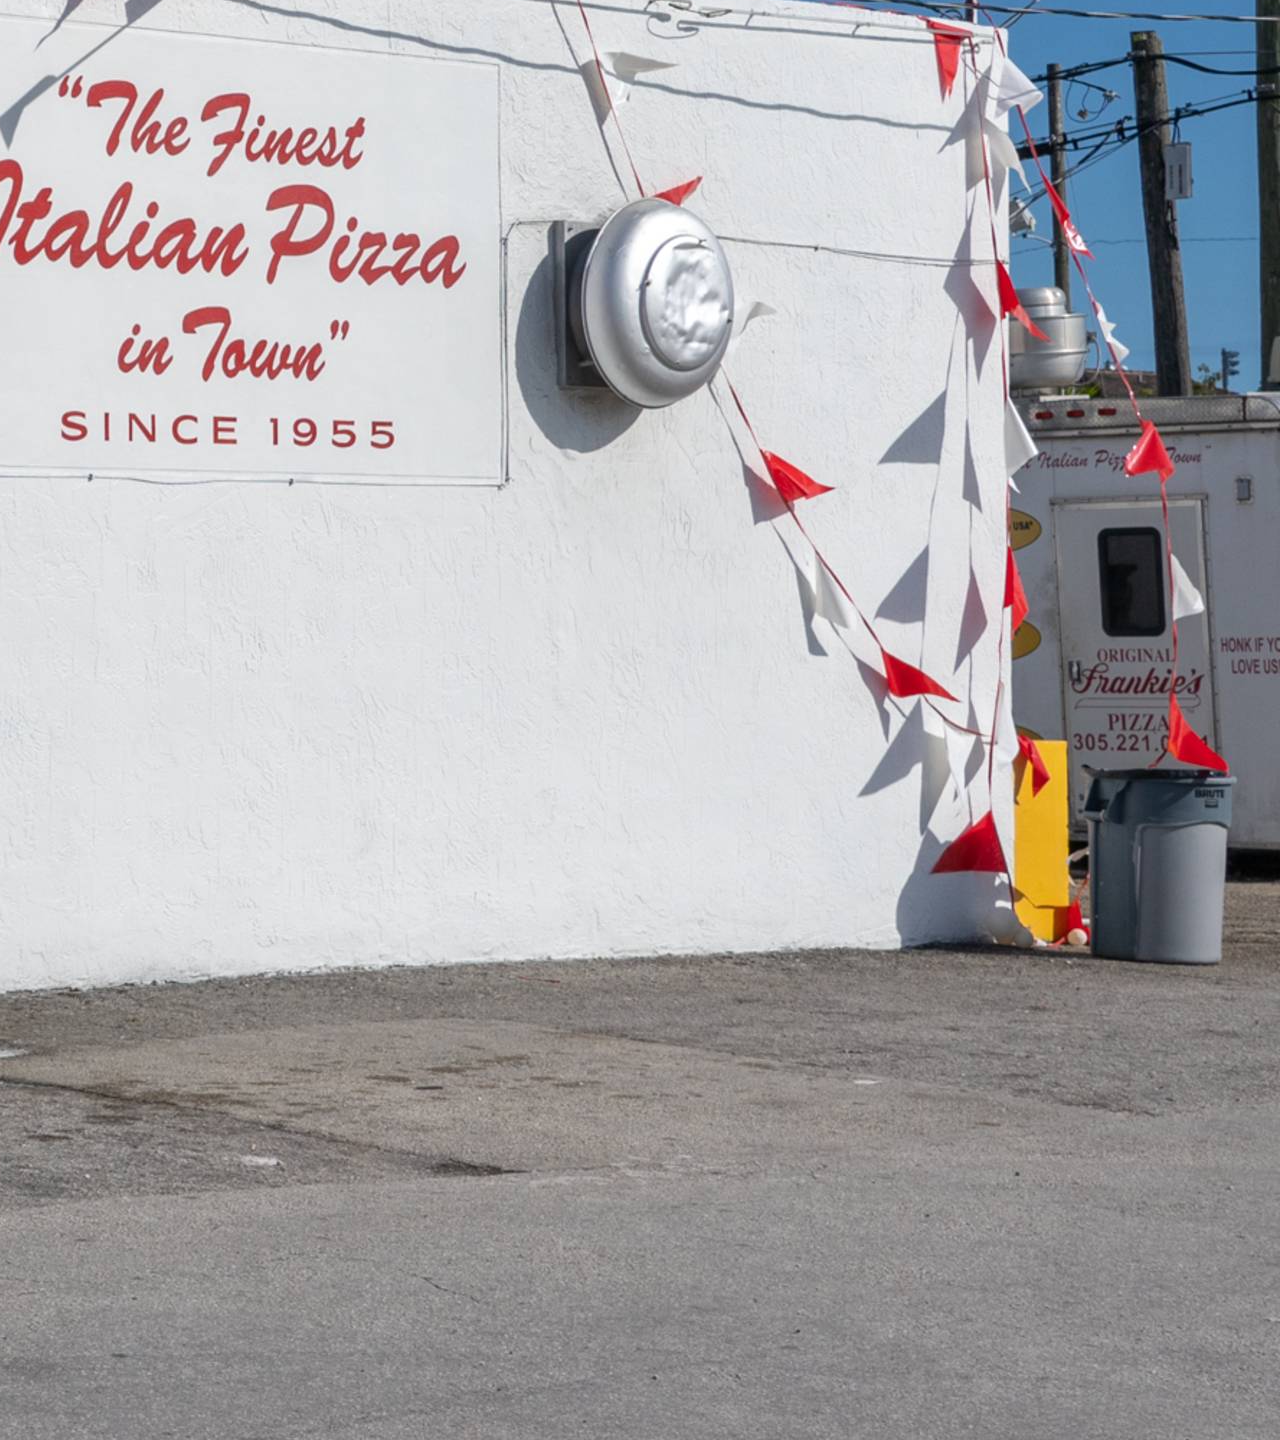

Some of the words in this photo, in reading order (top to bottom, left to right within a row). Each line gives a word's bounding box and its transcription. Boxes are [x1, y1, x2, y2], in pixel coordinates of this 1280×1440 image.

[58, 75, 191, 158] "The
[201, 92, 366, 177] Finest
[265, 184, 468, 289] Pizza
[118, 323, 174, 375] in
[182, 306, 351, 382] Town"
[60, 410, 239, 445] SINCE
[269, 417, 396, 449] 1955
[1038, 451, 1089, 470] Italian
[1094, 449, 1130, 471] Pizz
[1096, 648, 1175, 662] ORIGINAL
[1220, 637, 1252, 653] HONK
[1255, 637, 1265, 653] IF
[1232, 658, 1261, 674] LOVE
[1071, 662, 1205, 695] Frankie's
[1108, 713, 1170, 732] PIZZA
[1074, 733, 1209, 752] 305.221.01
